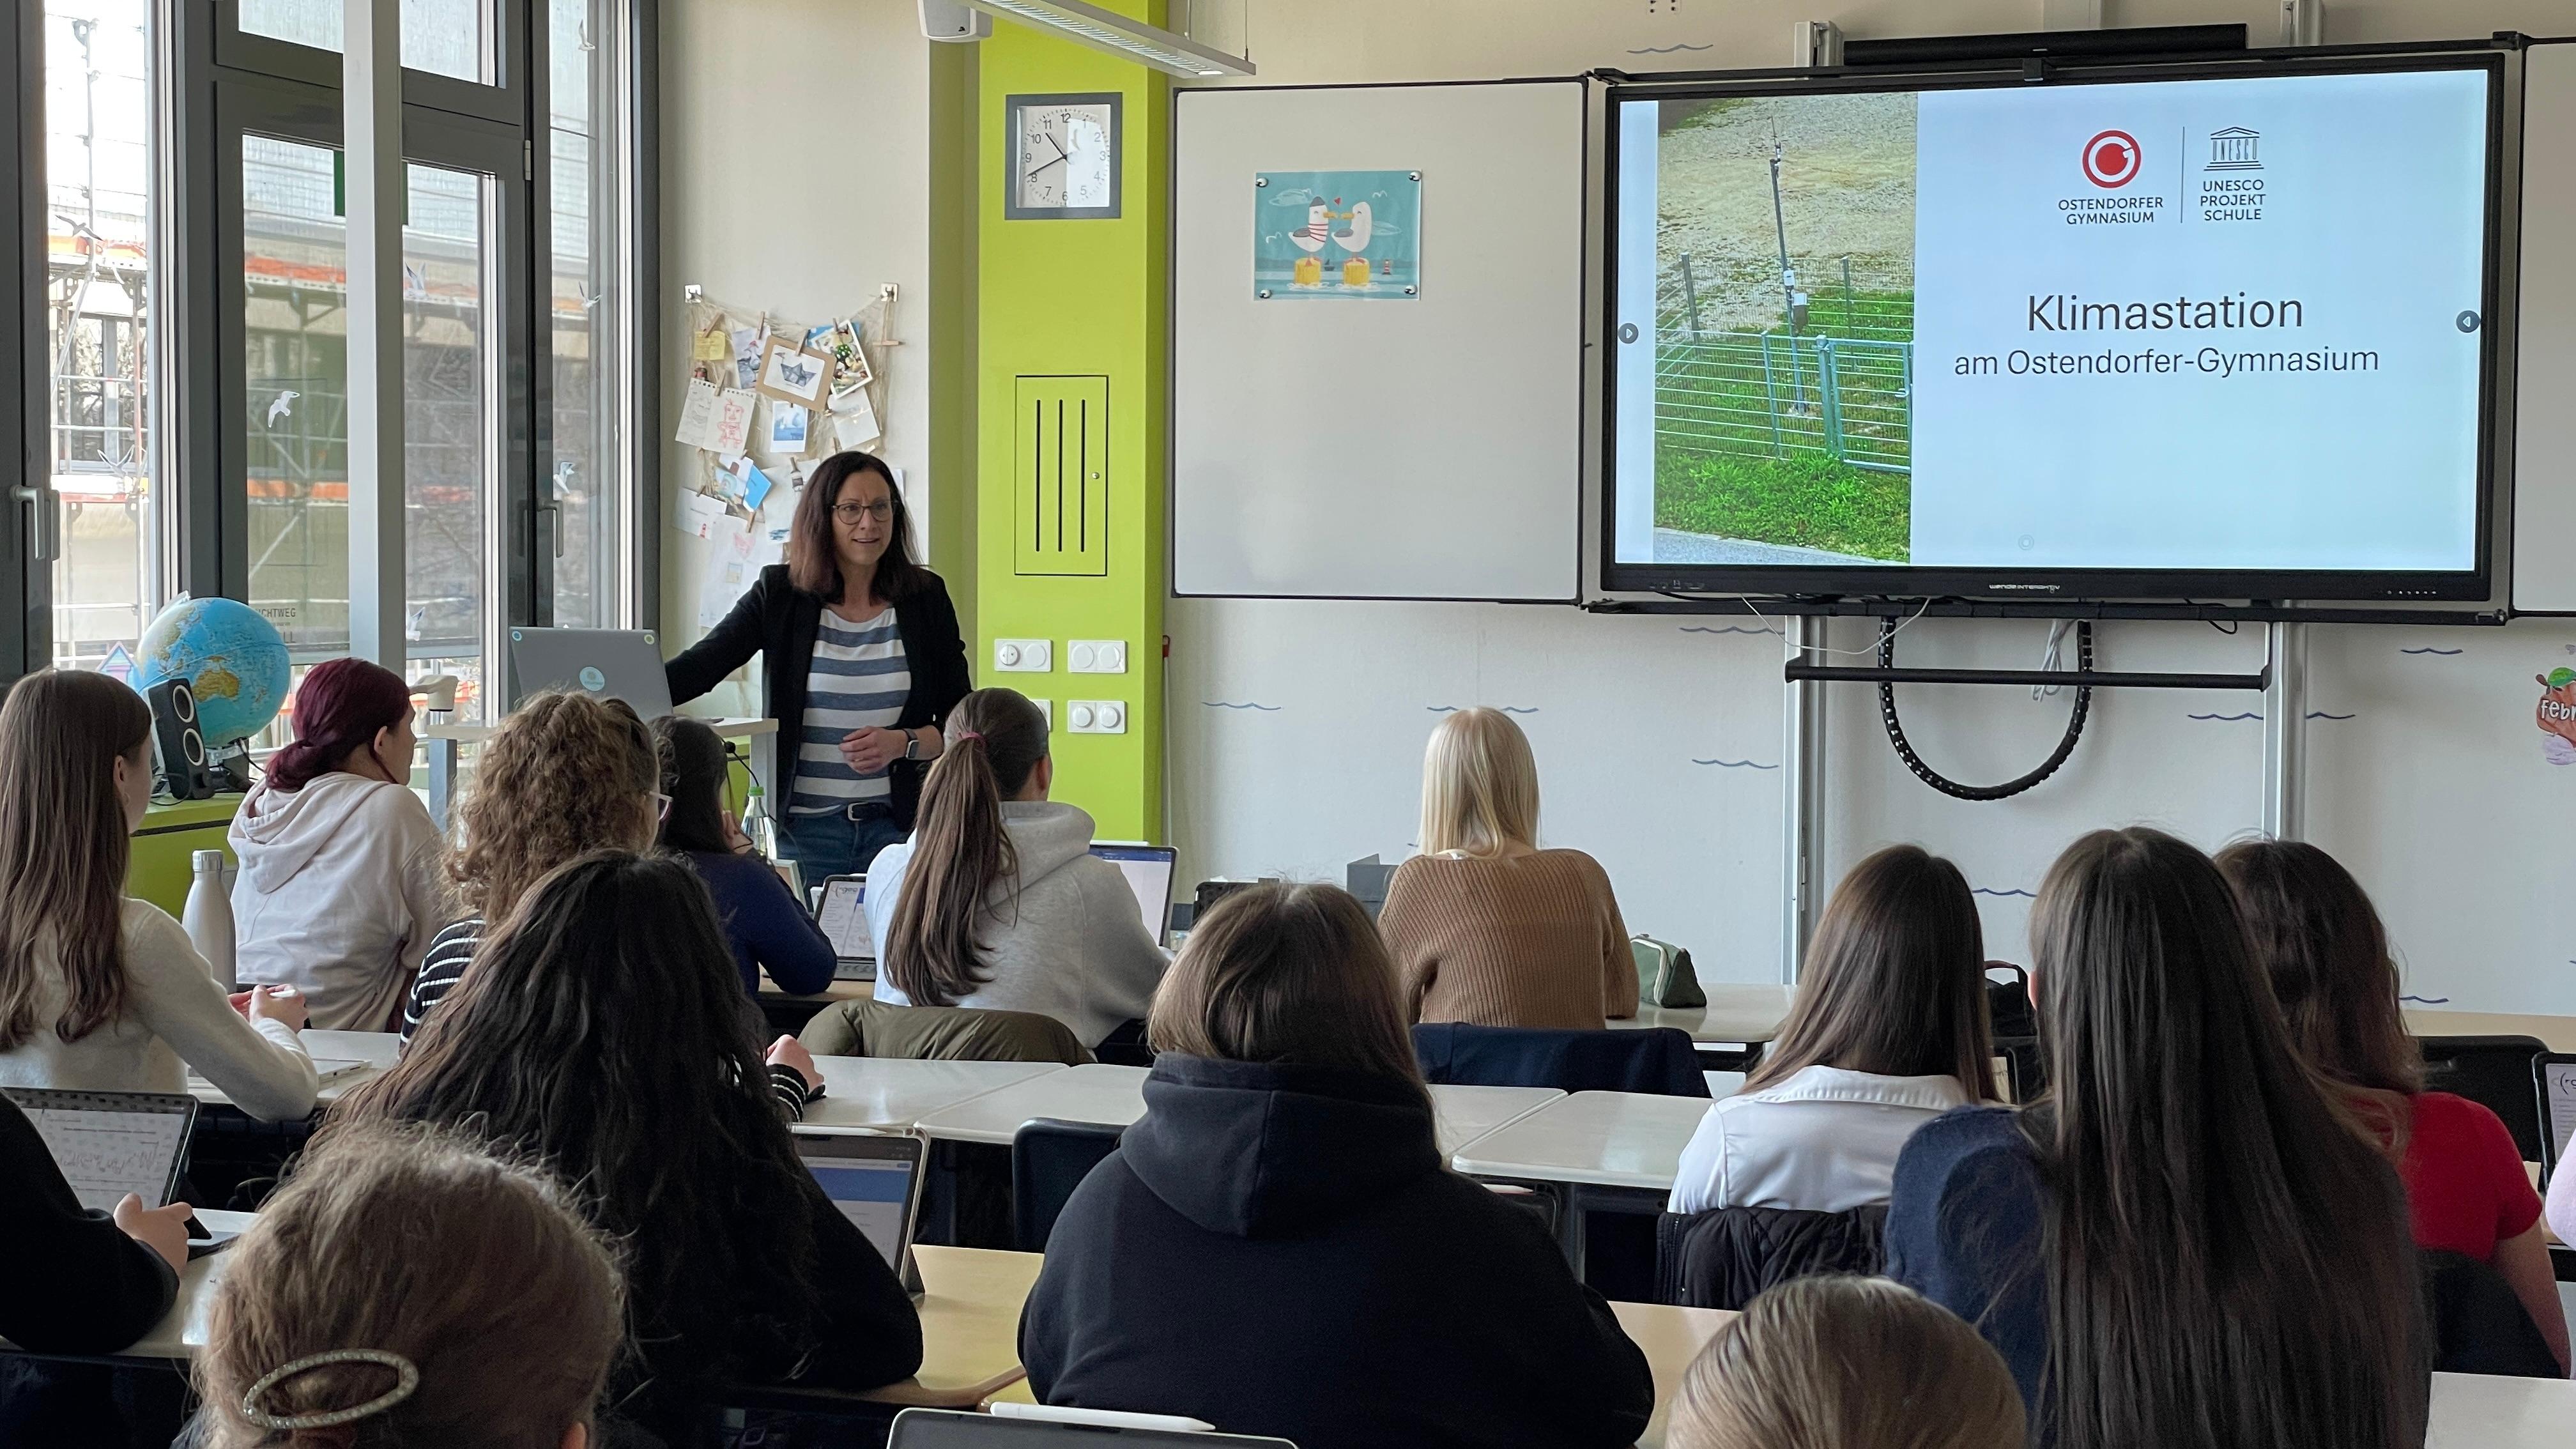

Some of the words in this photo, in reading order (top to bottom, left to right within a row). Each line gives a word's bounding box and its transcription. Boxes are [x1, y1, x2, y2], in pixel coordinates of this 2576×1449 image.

[1061, 112, 1071, 123] 12
[1043, 119, 1052, 130] 11
[1031, 134, 1041, 144] 10
[1094, 132, 1101, 142] 2
[2212, 138, 2257, 160] UNESCO
[1025, 153, 1032, 163] 9
[1100, 151, 1106, 160] 3
[1031, 172, 1038, 183] 8
[1094, 171, 1101, 181] 4
[1080, 185, 1087, 195] 5
[2203, 179, 2264, 191] UNESCO
[1045, 186, 1052, 197] 7
[1062, 191, 1068, 201] 6
[2058, 196, 2163, 210] OSTENDORFER
[2200, 194, 2266, 206] PROJEKT
[2066, 211, 2154, 224] GYMNASIUM
[2204, 208, 2261, 220] SCHULE
[2027, 291, 2303, 332] Klimastation
[1954, 355, 1998, 375] am
[2007, 345, 2379, 379] Ostendorfer-Gymnasium
